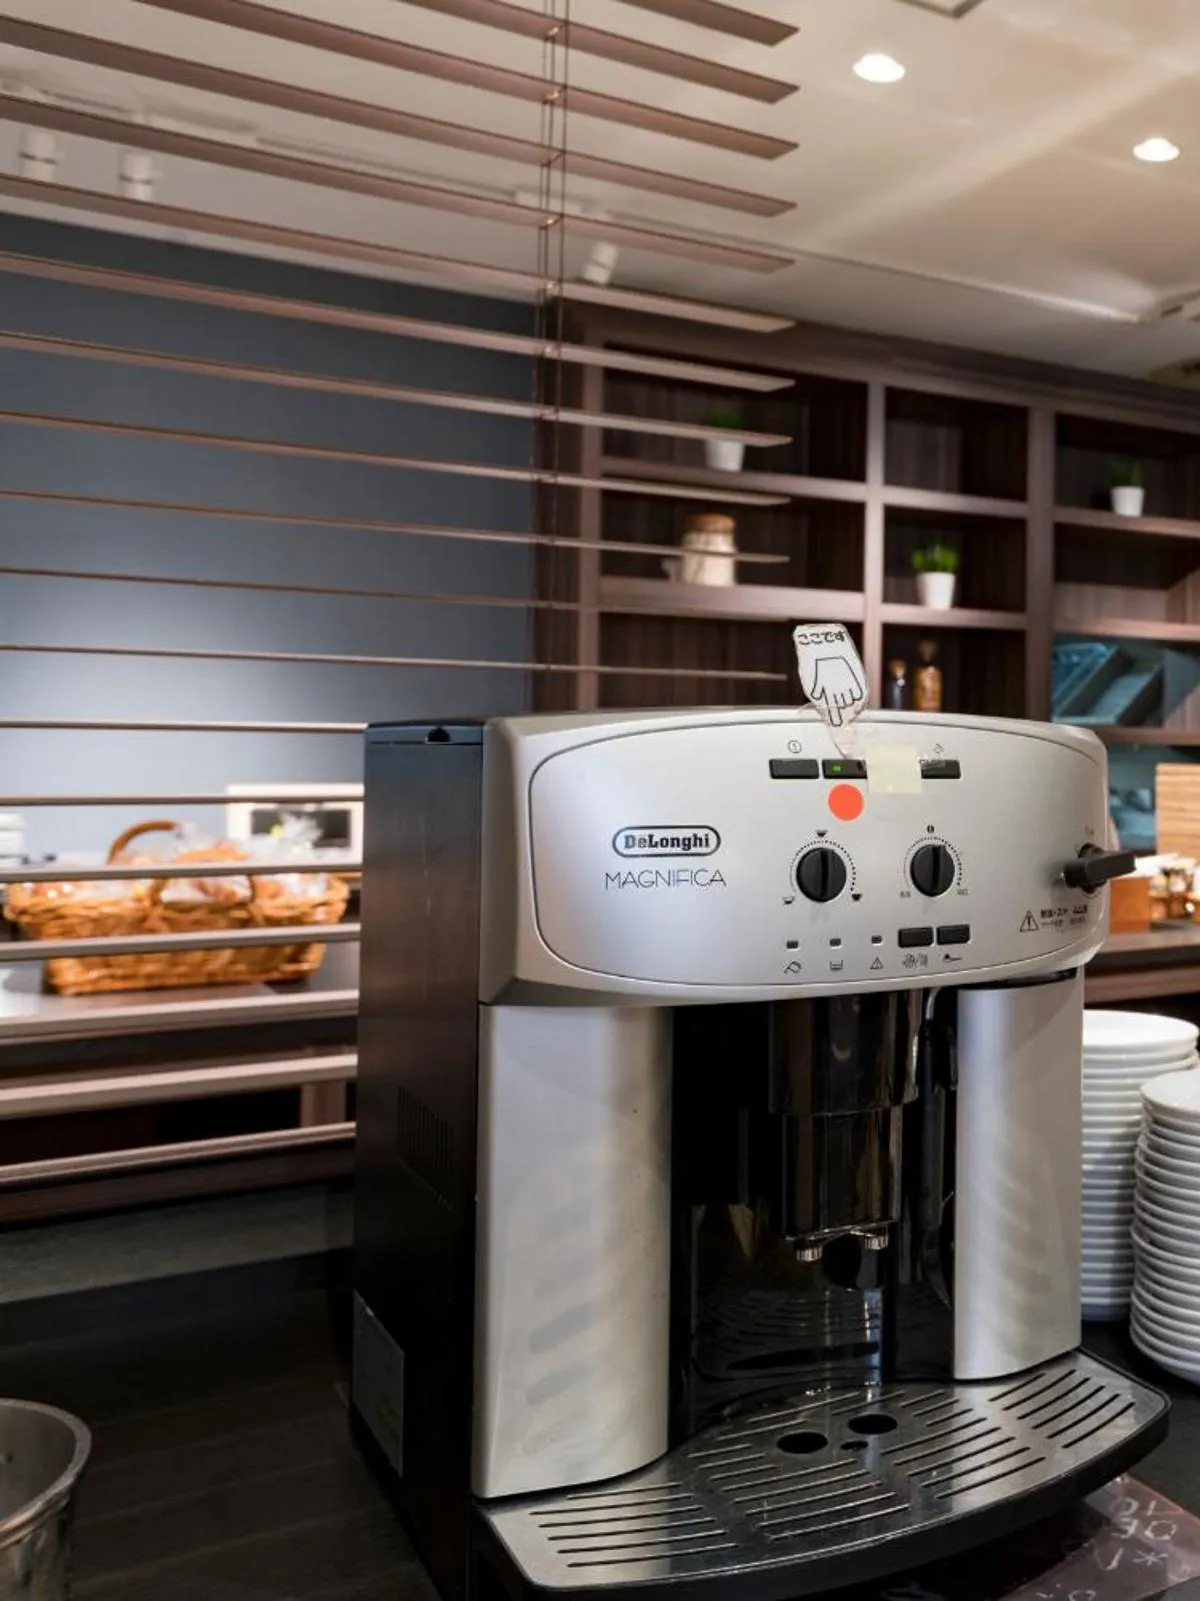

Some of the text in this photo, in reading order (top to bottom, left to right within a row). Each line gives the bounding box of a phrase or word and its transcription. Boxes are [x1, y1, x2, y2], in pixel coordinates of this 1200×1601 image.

[798, 631, 846, 645] ここです
[624, 833, 710, 851] DeLonghi
[605, 868, 727, 890] MAGNIFICA
